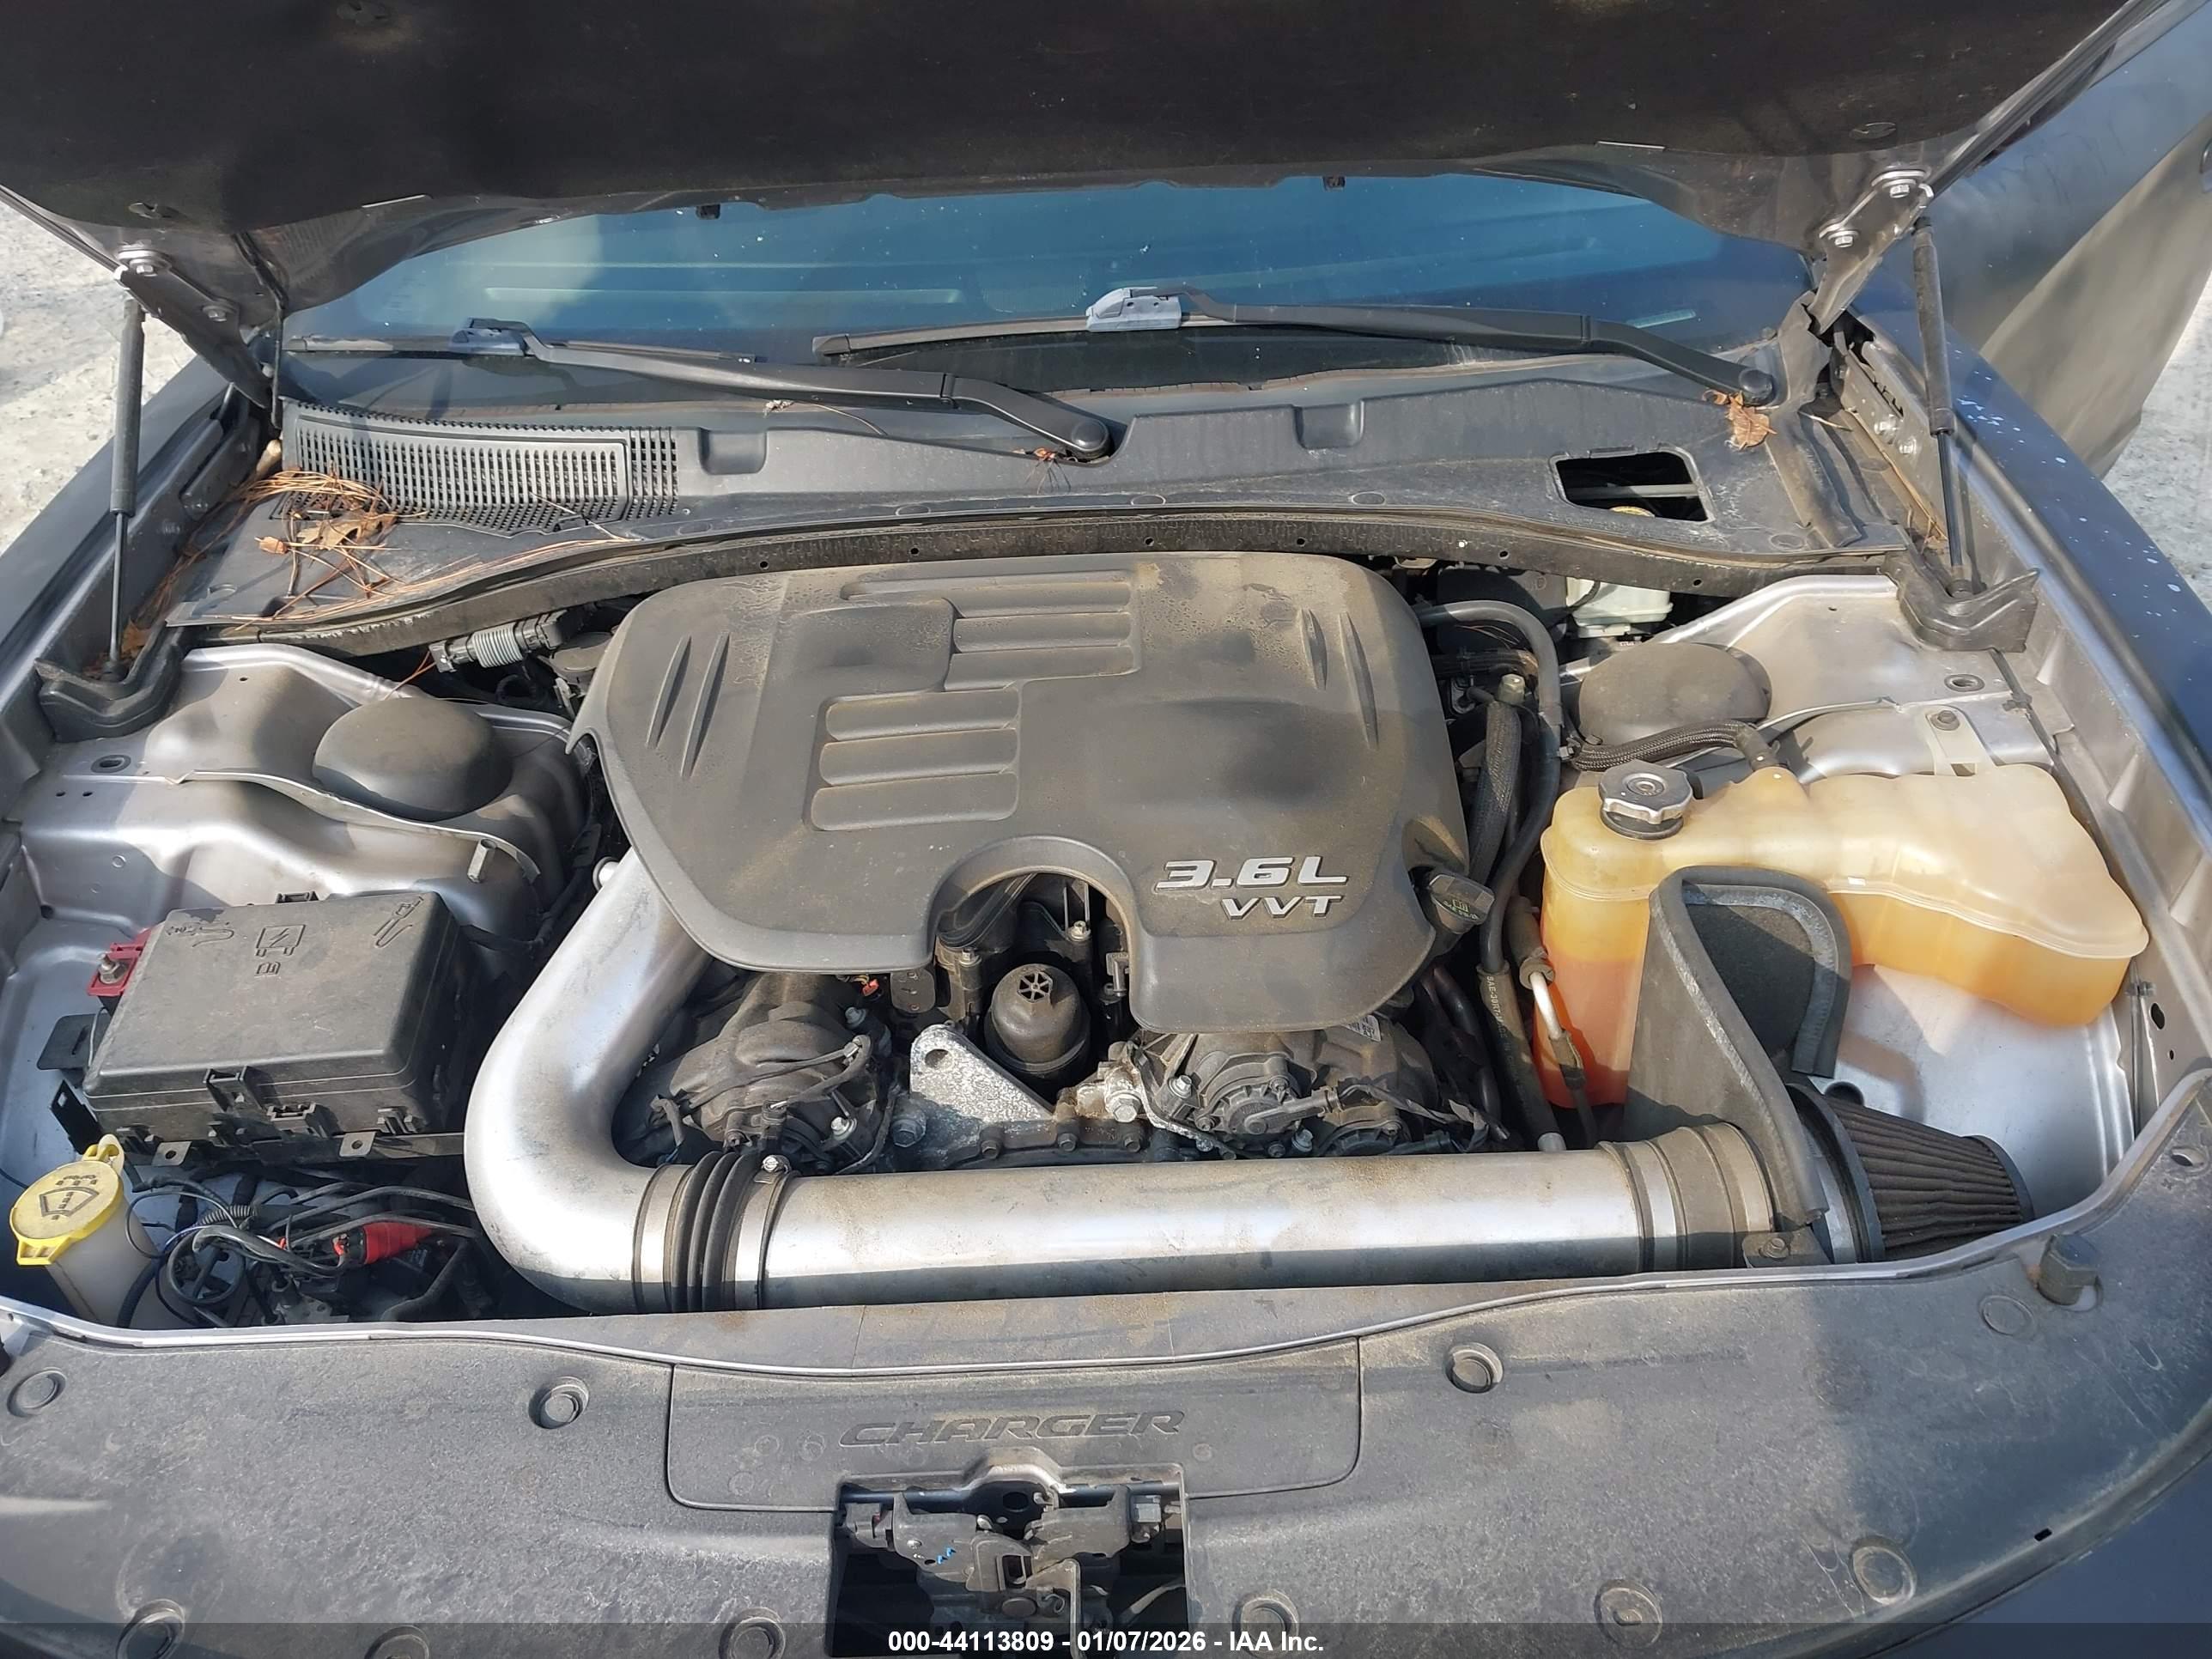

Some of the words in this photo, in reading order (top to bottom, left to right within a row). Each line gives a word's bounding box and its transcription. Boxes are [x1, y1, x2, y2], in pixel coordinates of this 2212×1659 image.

[1156, 856, 1347, 890] 3.6L
[1221, 895, 1343, 920] VVT
[839, 1410, 1185, 1447] CHARGER
